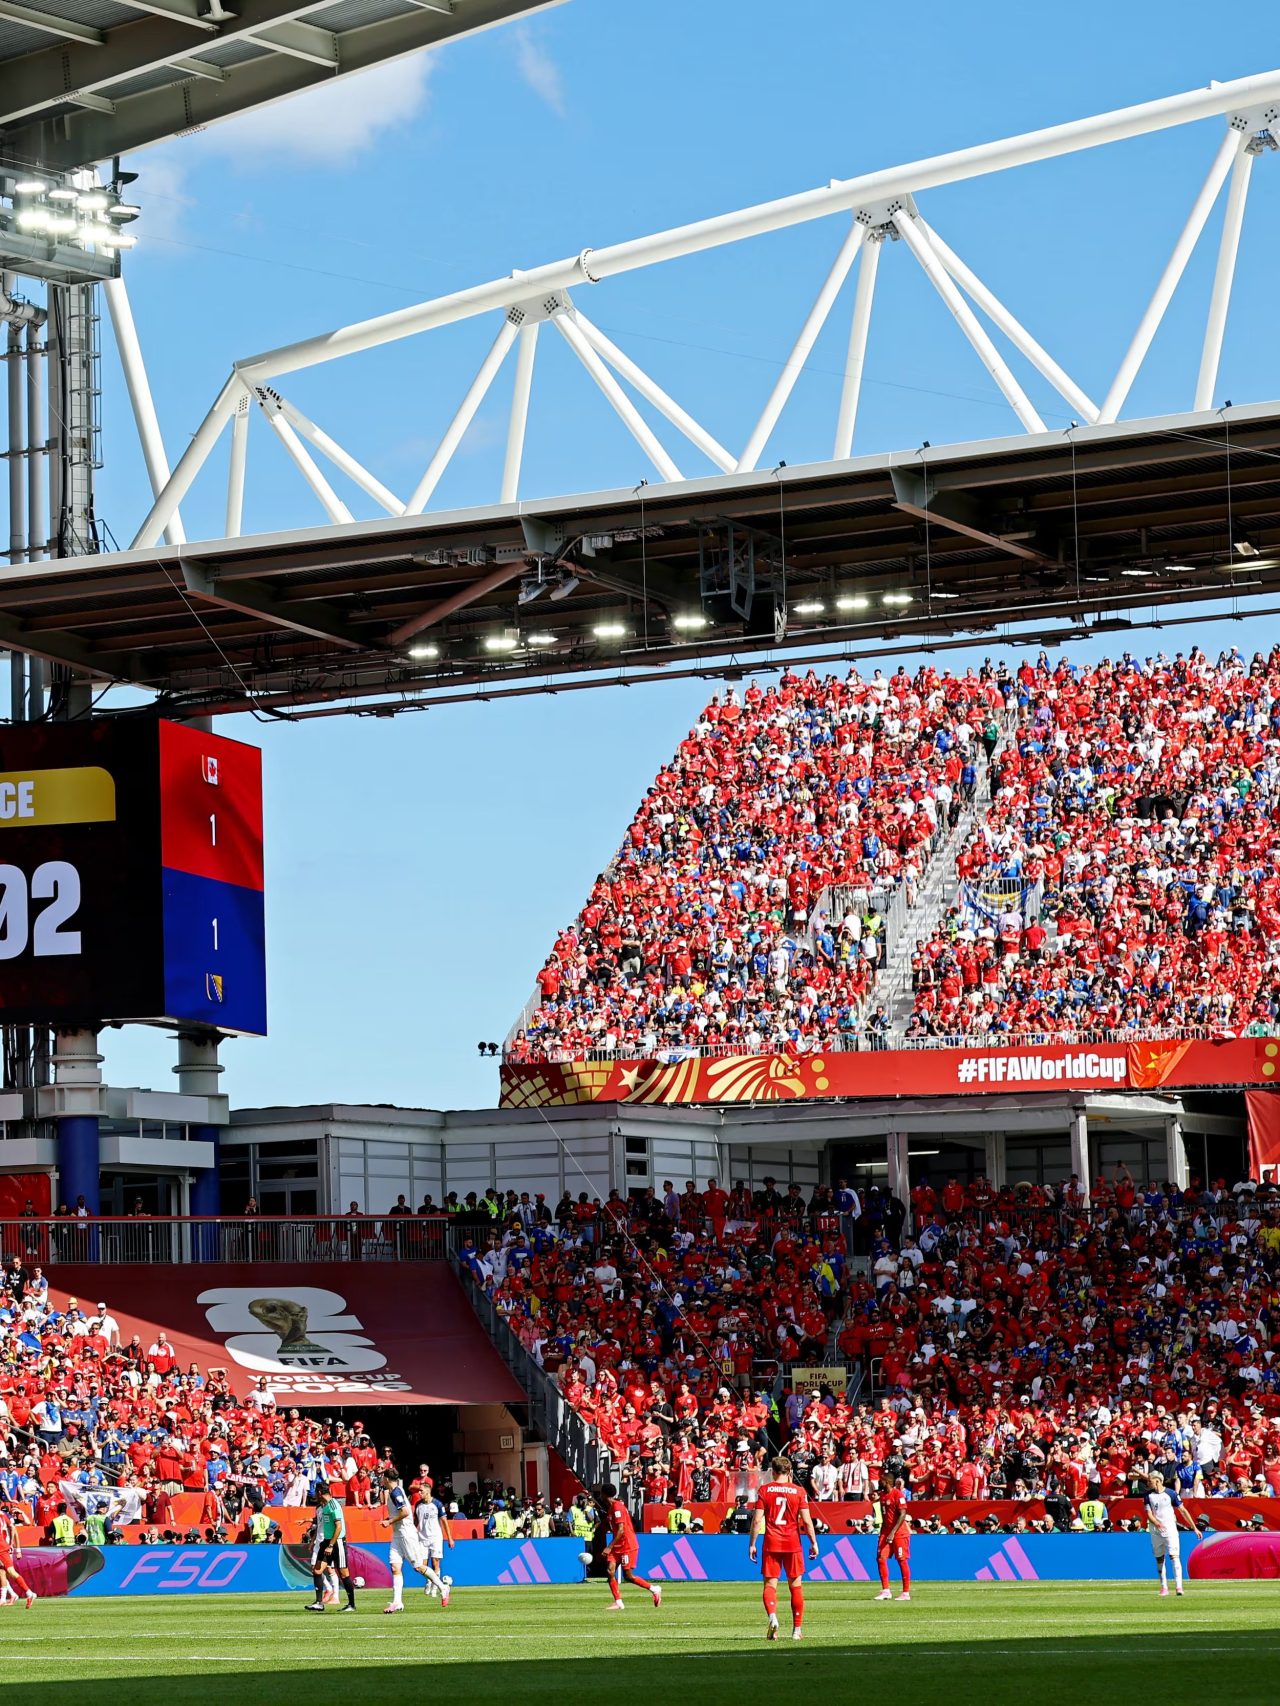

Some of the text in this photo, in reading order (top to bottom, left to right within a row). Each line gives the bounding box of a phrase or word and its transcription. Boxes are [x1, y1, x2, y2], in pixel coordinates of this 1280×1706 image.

[209, 814, 216, 847] 1
[211, 917, 218, 951] 1
[957, 1053, 1127, 1083] #FIFAWorldCup
[277, 1357, 349, 1366] FIFA
[246, 1373, 402, 1383] WORLD CUP
[255, 1381, 413, 1394] 2026
[502, 1437, 513, 1447] EXIT
[226, 1473, 258, 1486] CANADA
[775, 1496, 788, 1526] 2
